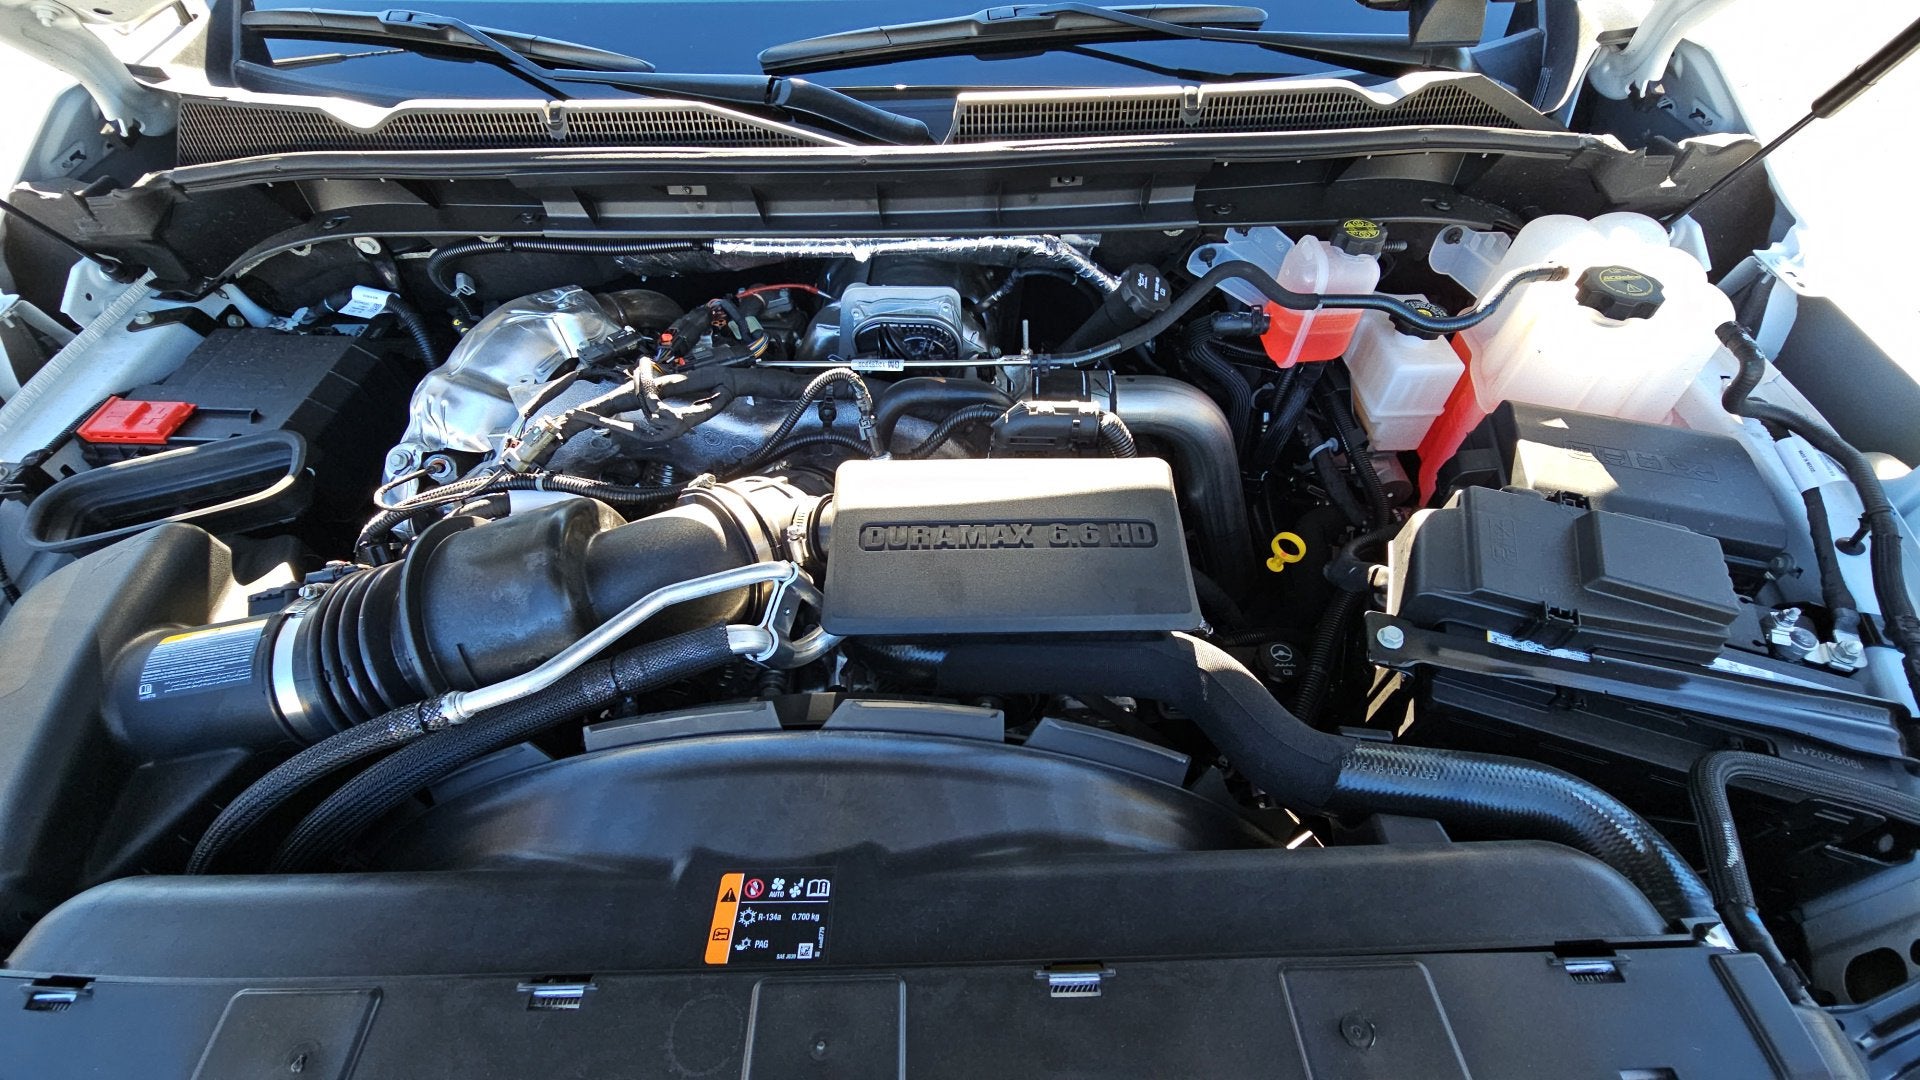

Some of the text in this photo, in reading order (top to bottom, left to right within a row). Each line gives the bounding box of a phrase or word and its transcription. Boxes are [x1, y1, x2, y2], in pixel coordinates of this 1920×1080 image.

[887, 361, 899, 369] GM
[864, 522, 1154, 549] DURAMAX 6.6 HD
[768, 890, 785, 898] AUTO
[758, 913, 820, 922] R-134a 0.700 kg
[754, 940, 769, 949] PAG
